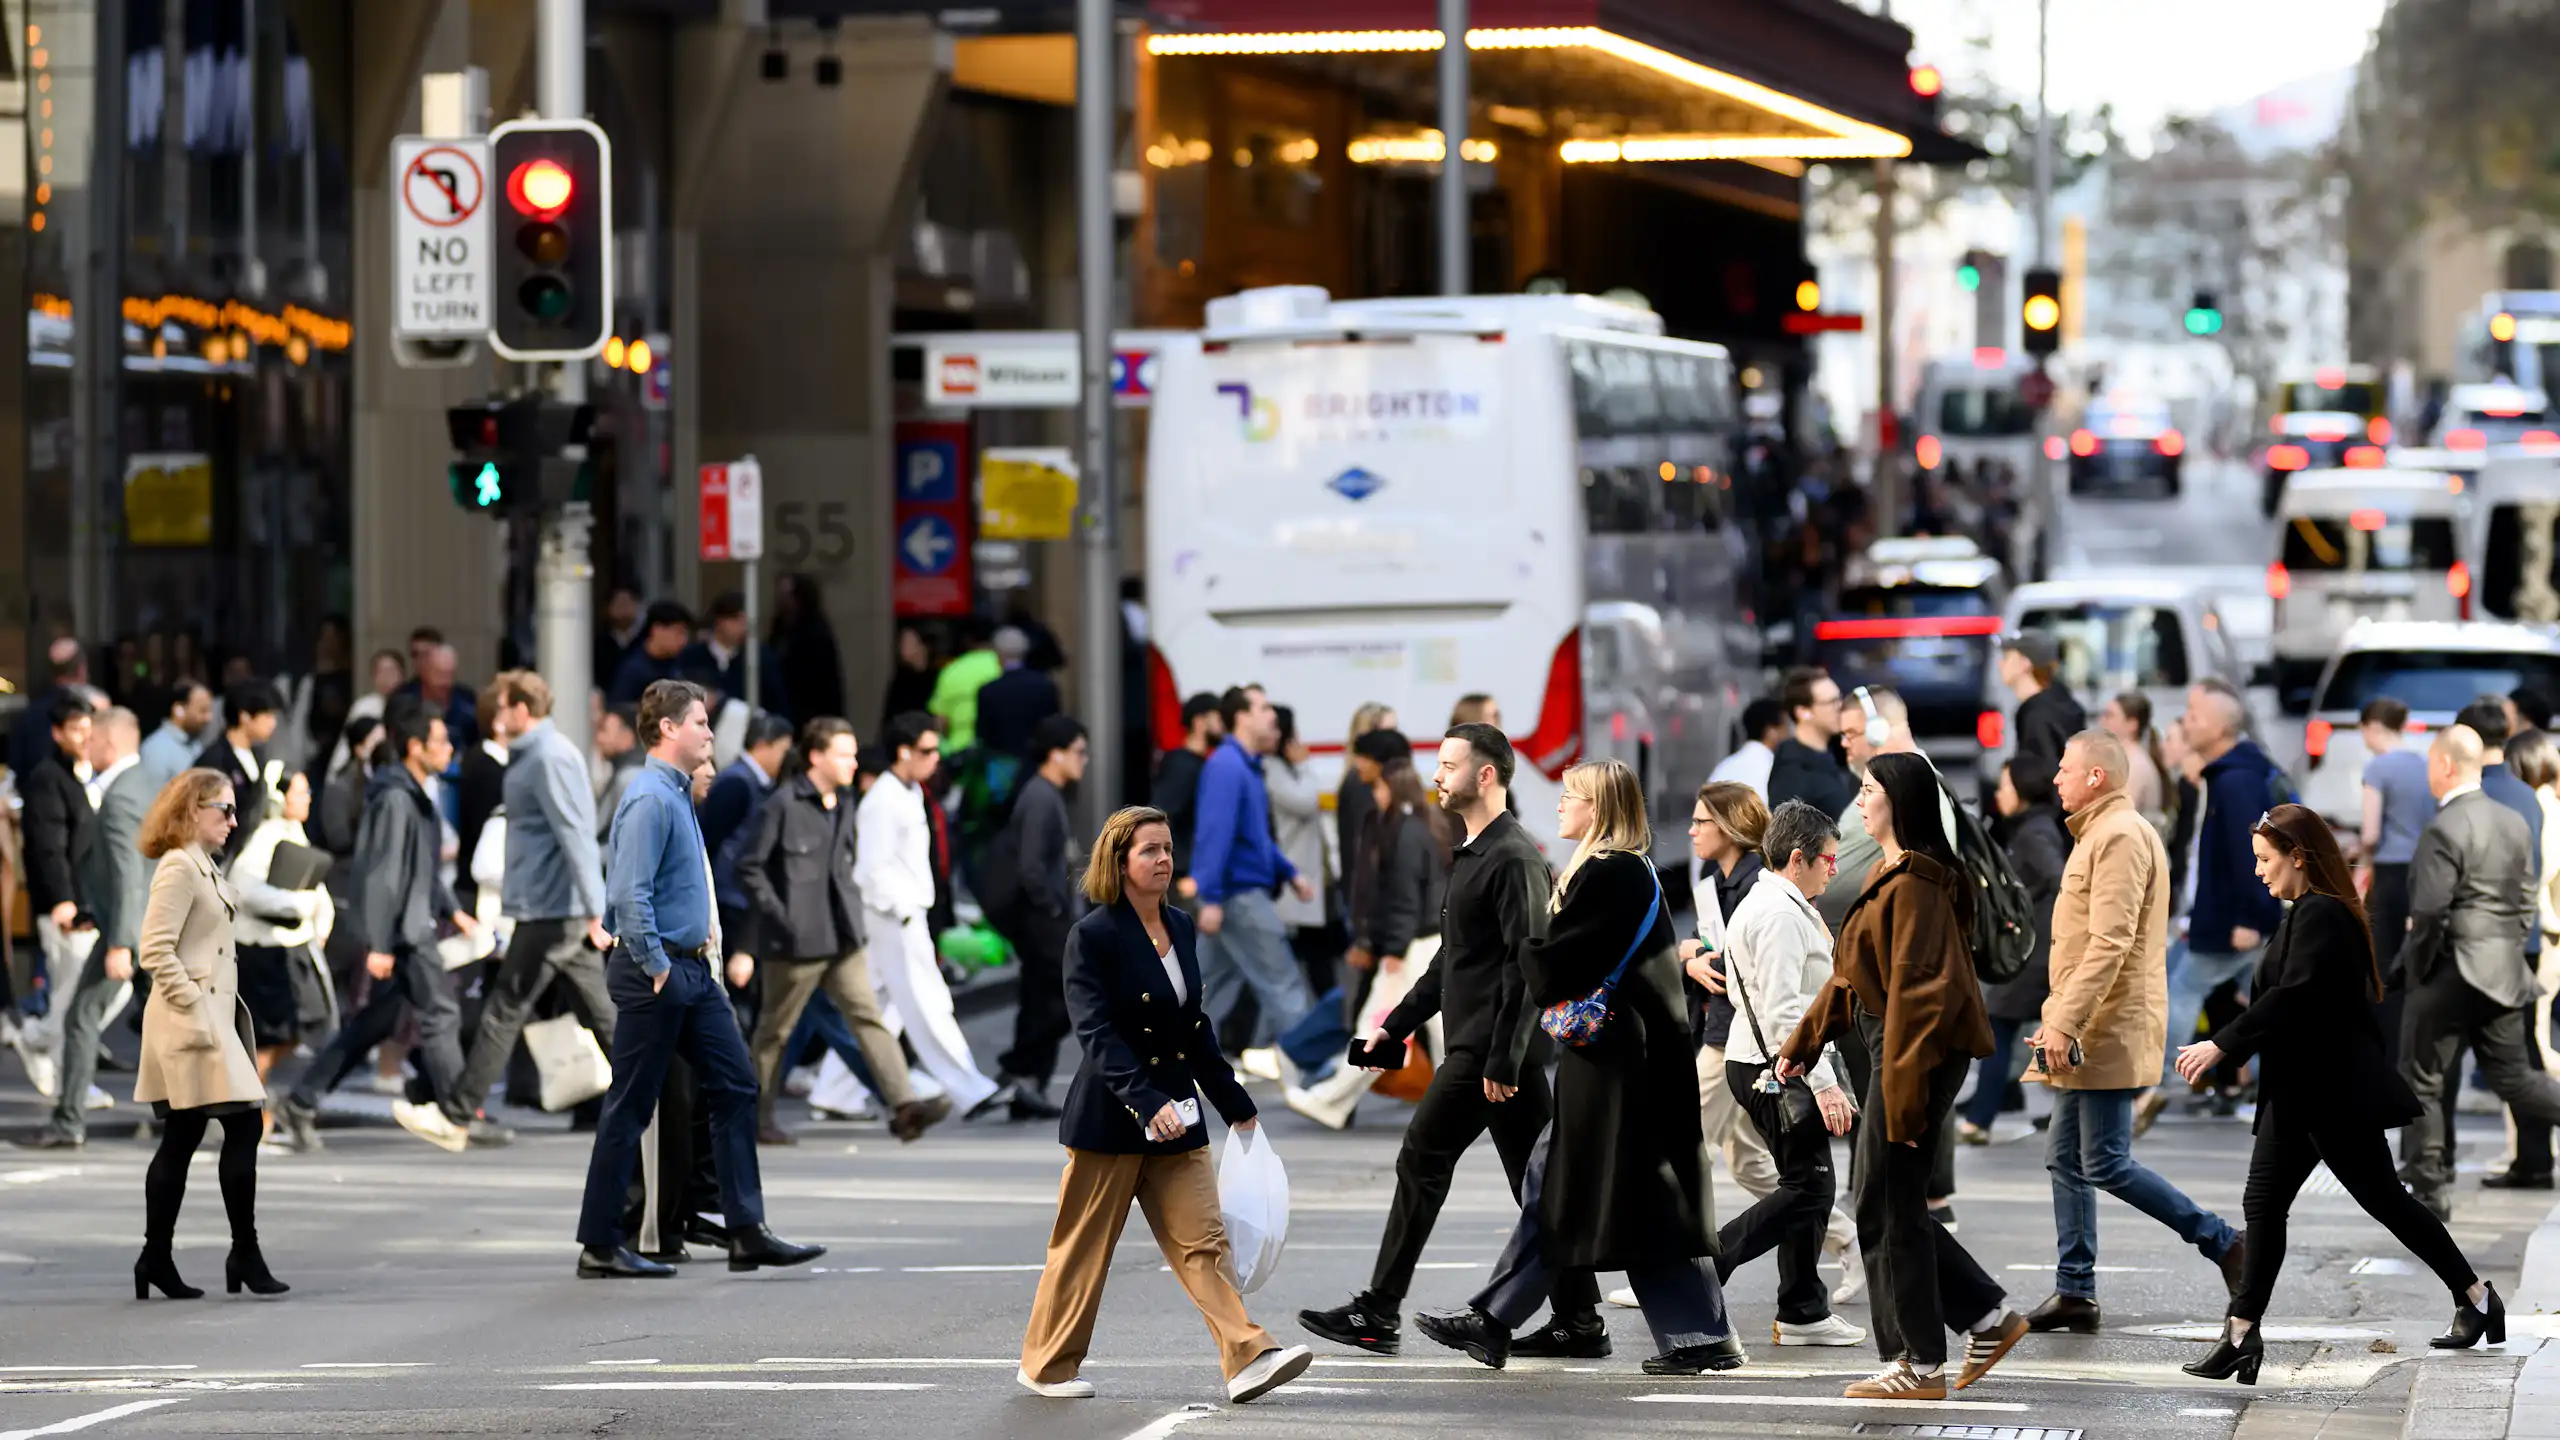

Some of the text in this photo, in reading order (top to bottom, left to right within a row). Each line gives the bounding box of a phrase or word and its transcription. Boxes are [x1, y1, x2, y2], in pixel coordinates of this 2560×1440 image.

[418, 236, 469, 266] NO
[412, 273, 475, 295] LEFT
[412, 302, 479, 321] TURN
[1304, 390, 1480, 420] BRIGHTON
[908, 449, 944, 493] P
[773, 502, 855, 566] 55
[1347, 1313, 1367, 1328] N
[1552, 1329, 1571, 1344] N
